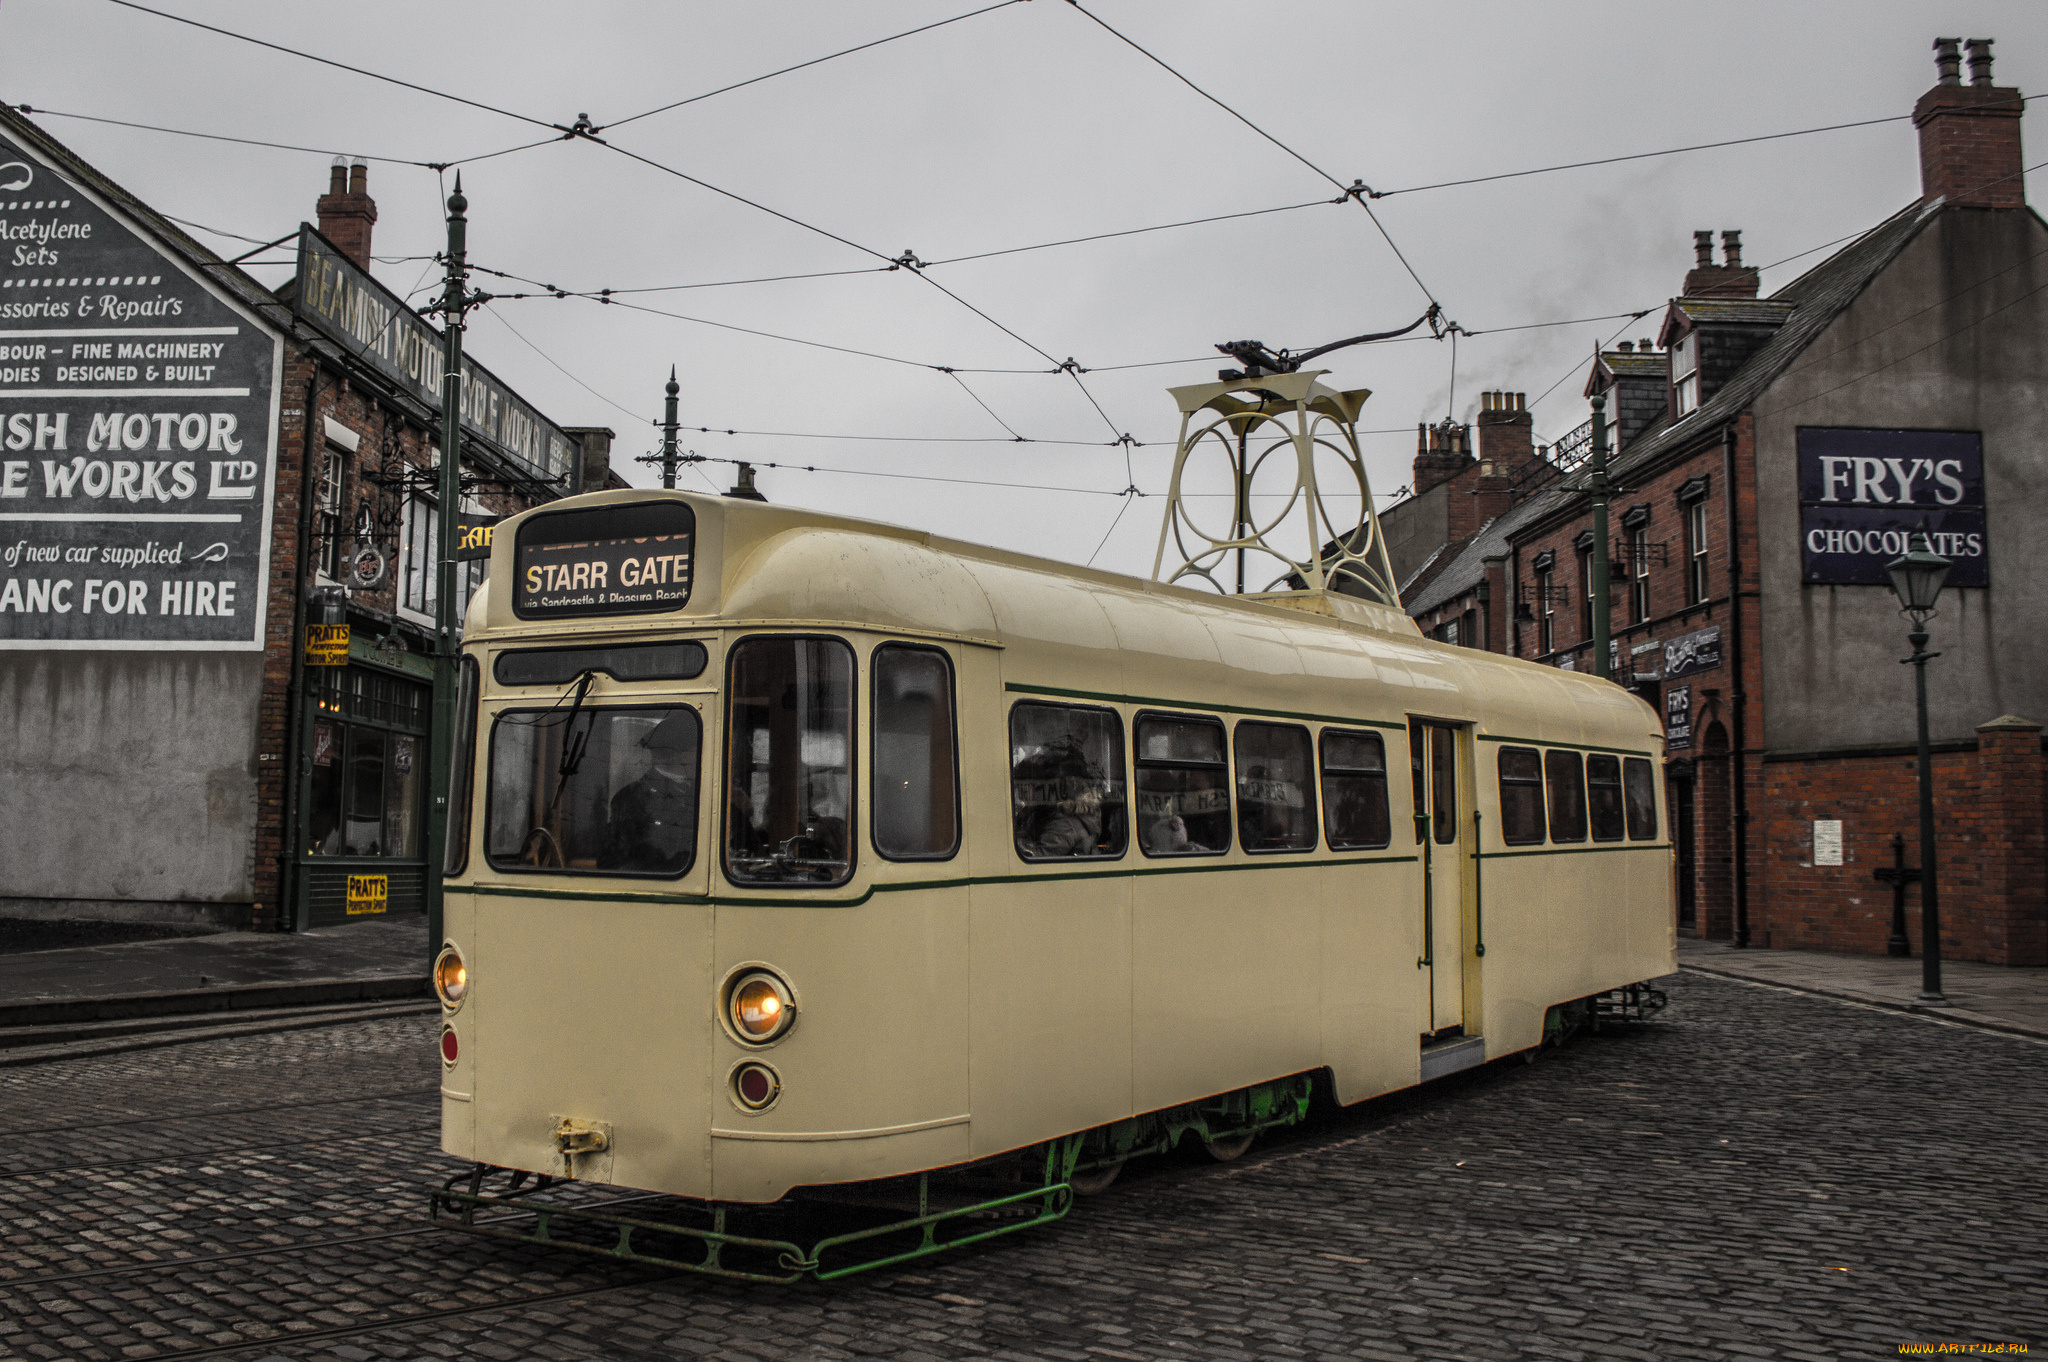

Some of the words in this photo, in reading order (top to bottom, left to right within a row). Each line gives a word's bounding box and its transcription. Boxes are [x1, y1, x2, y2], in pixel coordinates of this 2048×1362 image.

[0, 218, 91, 245] Acetylene
[11, 244, 59, 266] Sets
[0, 295, 70, 318] ssories
[78, 295, 93, 317] &
[99, 294, 183, 322] Repairs
[0, 344, 46, 360] BOUR
[72, 343, 112, 359] FINE
[117, 343, 225, 359] MACHINERY
[306, 248, 390, 360] BEAMISH
[394, 316, 444, 397] MOTOR
[460, 367, 498, 437] CYCLE
[500, 400, 540, 466] WORKS
[0, 367, 40, 383] DIES
[57, 366, 137, 382] DESIGNED
[146, 366, 159, 381] &
[165, 365, 215, 381] BUILT
[87, 412, 243, 455] MOTOR
[0, 460, 30, 499] E
[42, 456, 197, 503] WORKS
[1818, 455, 1964, 505] FRY'S
[4, 540, 27, 567] of
[26, 545, 60, 563] new
[65, 546, 98, 563] car
[101, 541, 183, 568] supplied
[526, 561, 608, 594] STARR
[620, 553, 689, 587] GATE
[0, 578, 74, 613] ANC
[82, 579, 148, 615] FOR
[160, 580, 236, 616] HIRE
[307, 625, 349, 647] PRATT'S
[349, 877, 386, 897] PRATT'S
